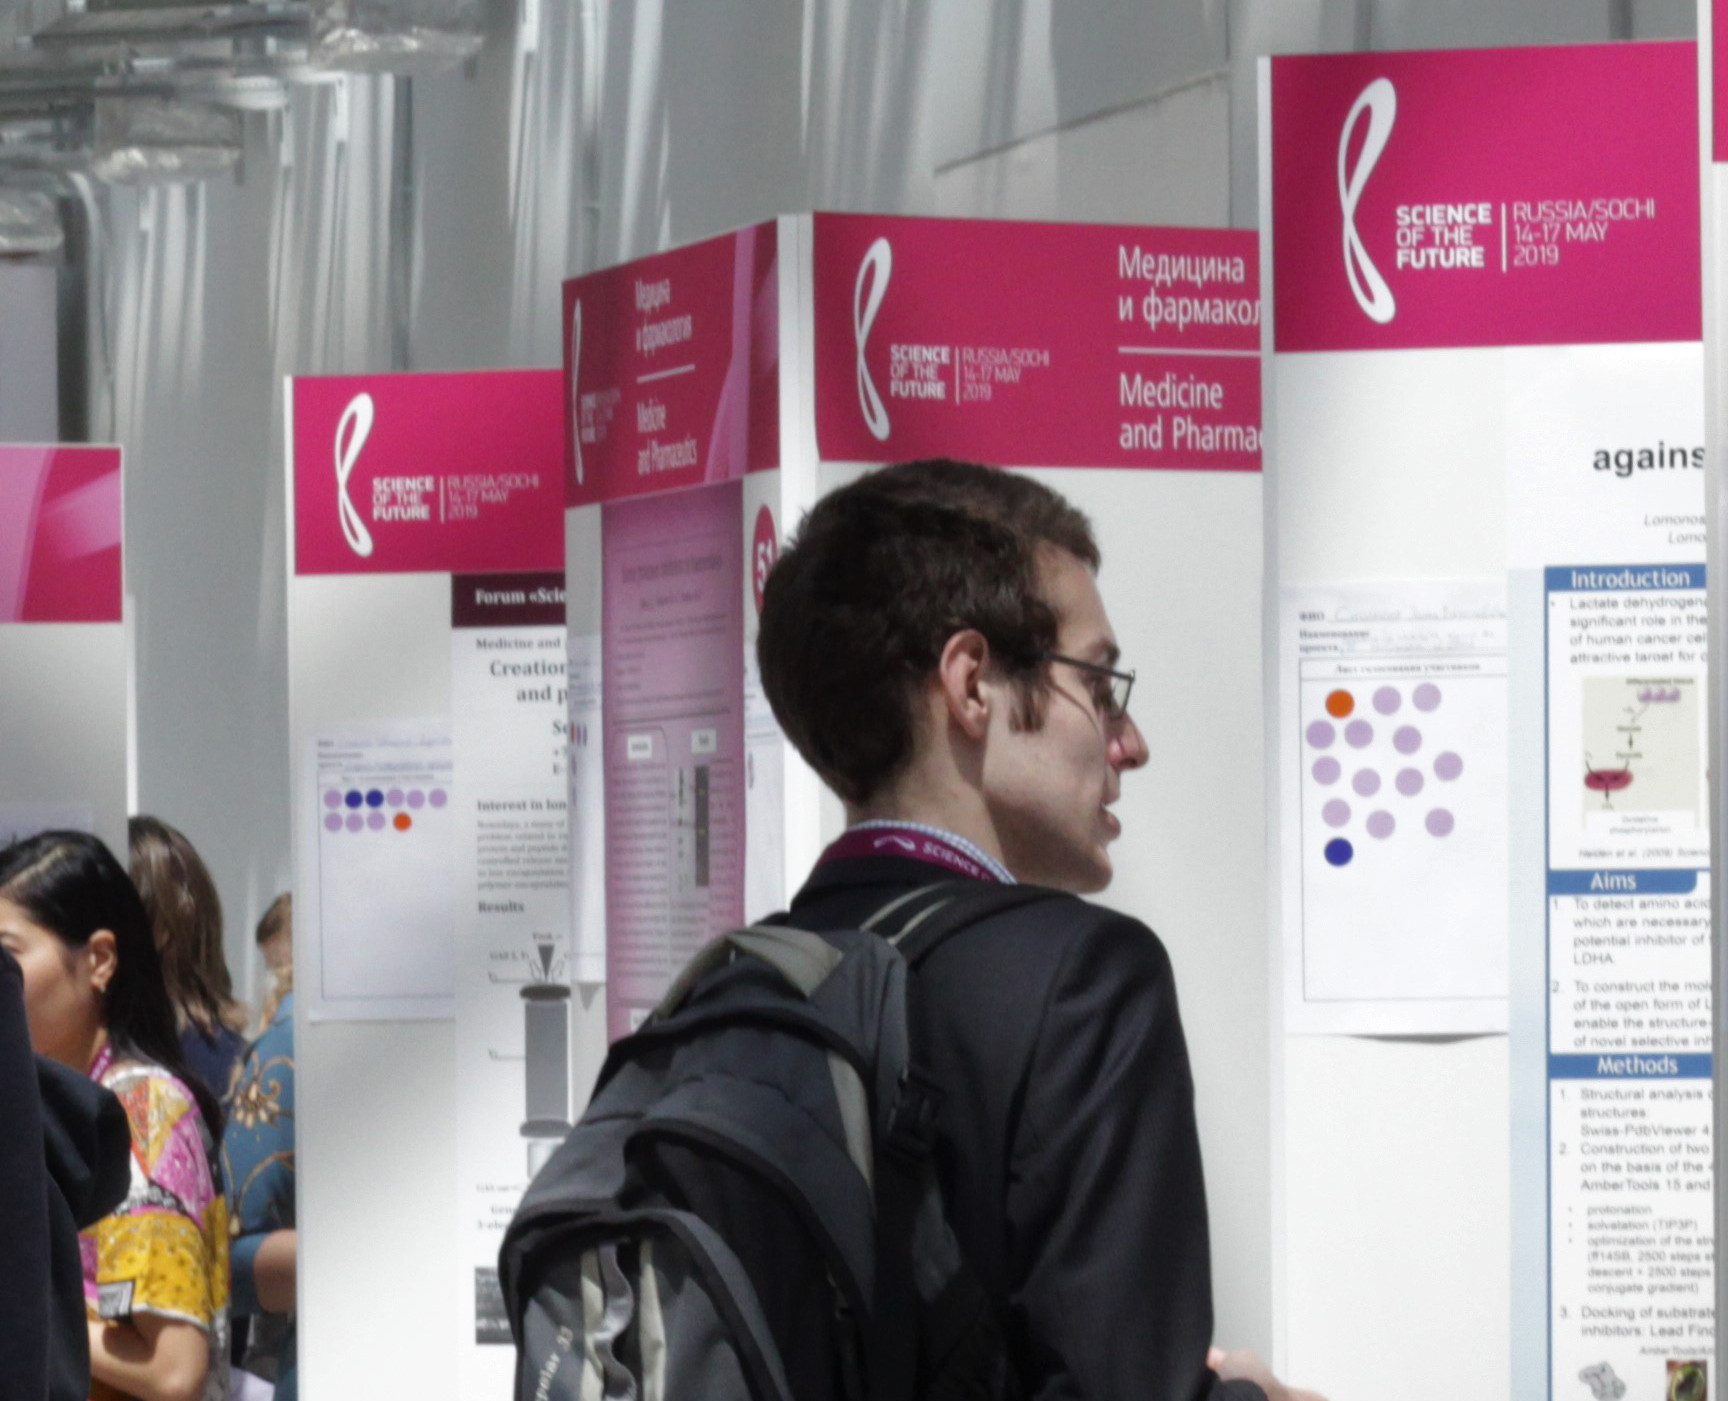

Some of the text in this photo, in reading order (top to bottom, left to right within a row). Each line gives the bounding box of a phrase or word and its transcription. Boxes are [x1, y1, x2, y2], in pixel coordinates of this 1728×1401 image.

[1396, 202, 1492, 226] SCIENCE
[1513, 198, 1655, 222] RUSSIA/SOCHI
[1395, 226, 1473, 247] OF THE
[1513, 222, 1608, 243] 14-17 MAY
[1397, 247, 1484, 269] FUTURE
[1513, 245, 1559, 266] 2019
[1119, 244, 1245, 289] Медицина
[1119, 296, 1133, 322] и
[890, 344, 950, 365] SCIENCE
[963, 347, 1049, 367] RUSSIA/SOCHI
[890, 363, 938, 381] OF THE
[995, 367, 1022, 383] MAY
[890, 380, 946, 399] FUTURE
[963, 384, 992, 401] 2019
[1120, 371, 1223, 409] Medicine
[1120, 414, 1163, 449] and
[372, 475, 434, 492] SCIENCE
[372, 491, 422, 505] OF THE
[482, 489, 510, 503] MAY
[373, 505, 430, 521] FUTURE
[447, 504, 478, 518] 2019
[1572, 569, 1690, 588] Introduction
[475, 589, 526, 605] Forum
[1570, 616, 1637, 629] significant
[476, 639, 560, 649] Medicine and
[1586, 634, 1632, 645] human
[1637, 635, 1681, 645] cancer
[517, 685, 551, 702] and
[478, 801, 526, 811] Interest
[923, 841, 980, 875] SCIENCE
[1590, 871, 1637, 890] Aims
[1573, 917, 1611, 928] which
[1573, 935, 1630, 948] potential
[1597, 1055, 1679, 1074] Methods
